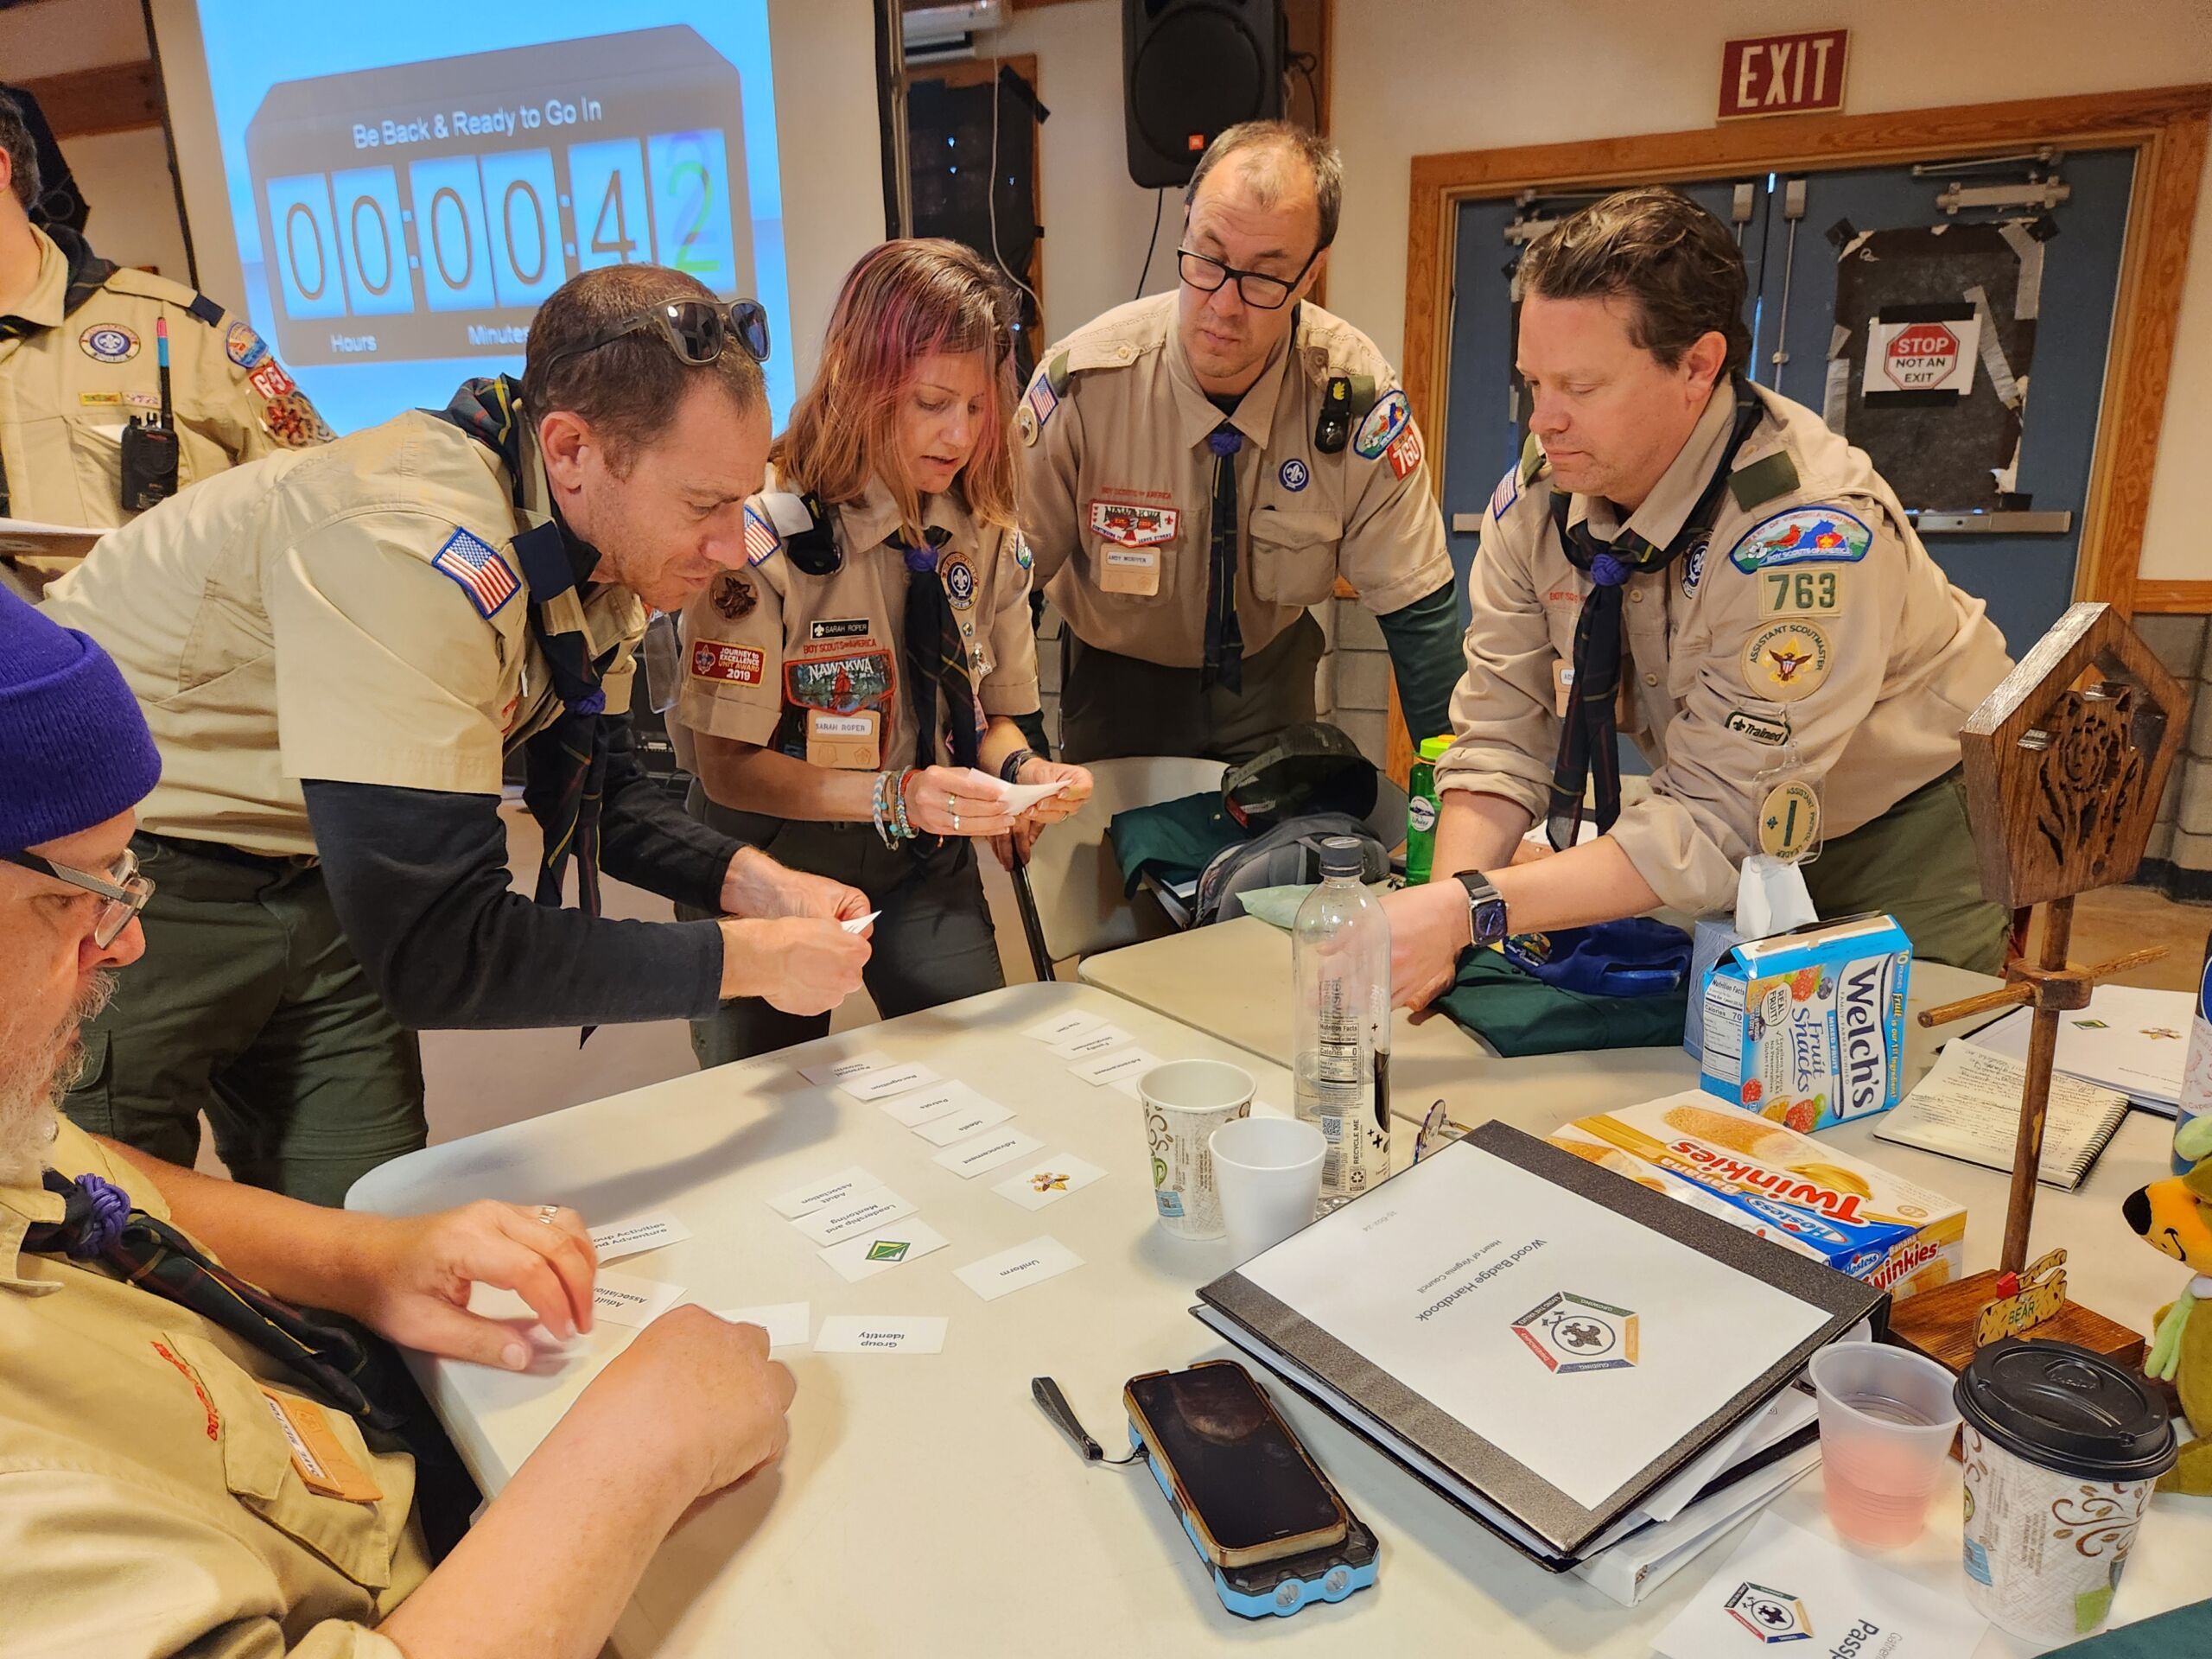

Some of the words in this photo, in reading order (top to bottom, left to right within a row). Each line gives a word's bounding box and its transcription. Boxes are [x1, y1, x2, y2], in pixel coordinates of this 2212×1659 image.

[1737, 38, 1834, 109] EXIT
[353, 124, 378, 149] Be
[381, 119, 429, 146] Back
[434, 118, 449, 138] &
[452, 107, 517, 138] Ready
[521, 105, 541, 129] to
[544, 102, 576, 126] Go
[582, 97, 602, 122] In
[331, 334, 377, 354] Hours
[1897, 336, 1949, 354] STOP
[1895, 358, 1924, 369] NOT
[1925, 357, 1946, 368] AN
[1904, 372, 1935, 383] EXIT
[1392, 434, 1421, 475] 760
[1768, 572, 1836, 611] 763
[825, 625, 845, 633] SARAH
[720, 647, 752, 656] JOURNEY
[803, 645, 817, 654] BOY
[819, 641, 844, 652] SCOUTS
[849, 639, 877, 648] AMERICA
[1750, 625, 1788, 664] ASSISTANT
[1789, 625, 1826, 671] SCOUTMASTER
[719, 654, 760, 666] EXCELLENCE
[734, 662, 760, 672] AWARD
[726, 668, 751, 681] 2019
[808, 658, 874, 685] NAWAKWA
[1745, 723, 1784, 742] Trained
[1786, 787, 1814, 809] ASSISTANT
[1897, 950, 1910, 965] 10
[1712, 979, 1732, 991] Nutrition
[1732, 985, 1745, 996] Facts
[1705, 1004, 1726, 1016] Calories
[1732, 1012, 1742, 1021] 70
[1770, 990, 1778, 1023] FRUIT!
[1892, 992, 1905, 1018] Fruit
[1846, 961, 1881, 1109] Welch's
[1320, 1047, 1343, 1056] Calories
[1352, 1047, 1357, 1056] 0
[1791, 1007, 1812, 1093] Snacks
[1808, 1021, 1827, 1080] Fruit
[835, 1065, 871, 1077] Personal
[1093, 1058, 1141, 1076] Advancement
[1890, 1056, 1899, 1097] Ingredient!
[871, 1074, 918, 1091] Recognition
[919, 1098, 949, 1110] Patrols
[958, 1120, 983, 1132] Ideals
[1353, 1119, 1360, 1132] ME
[962, 1140, 1016, 1165] Advancement
[1660, 1157, 1741, 1194] Banana
[1669, 1141, 1865, 1225] Twinkies
[800, 1183, 853, 1205] Association
[820, 1192, 846, 1205] Adult
[830, 1204, 879, 1225] Mentoring
[845, 1204, 896, 1227] Leadership
[1751, 1197, 1835, 1241] Hostess
[613, 1228, 667, 1244] Adventure
[617, 1223, 665, 1237] Activities
[825, 1222, 844, 1234] and
[1483, 1238, 1503, 1255] Heart
[1513, 1238, 1548, 1262] Wood
[1889, 1235, 1917, 1255] Banana
[1472, 1249, 1483, 1261] of
[1842, 1253, 1878, 1275] Hostess
[999, 1258, 1040, 1278] Uniform
[1445, 1255, 1474, 1277] Virginia
[1474, 1255, 1514, 1285] Badge
[1416, 1272, 1447, 1295] Council
[594, 1297, 624, 1308] Adult
[1415, 1280, 1478, 1323] Handbook
[1580, 1298, 1613, 1312] GROWING
[2008, 1300, 2035, 1325] BEAR
[858, 1332, 906, 1340] Identity
[860, 1339, 898, 1348] Group
